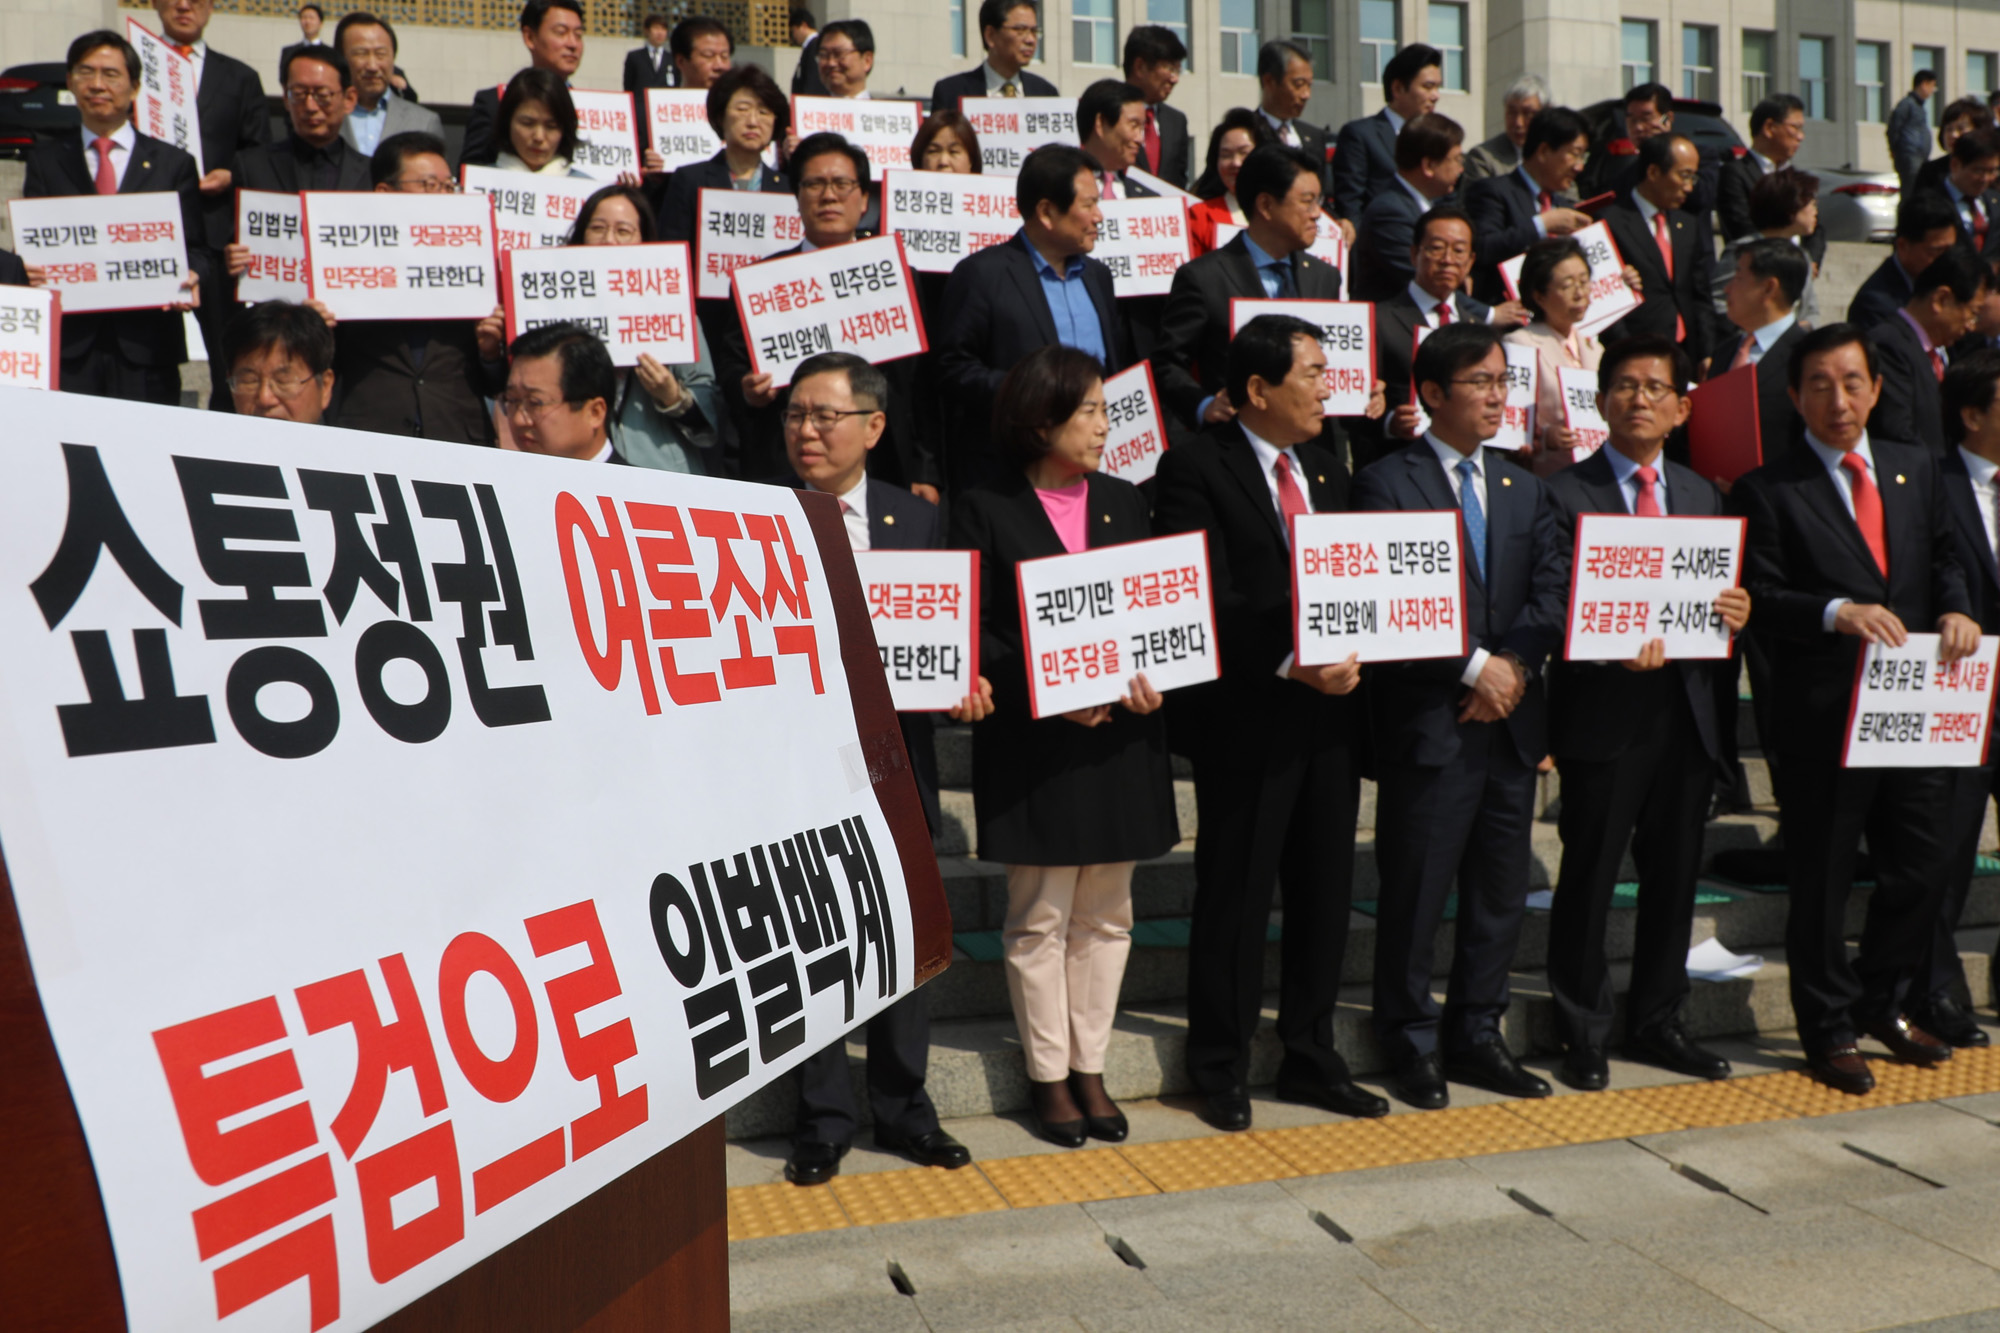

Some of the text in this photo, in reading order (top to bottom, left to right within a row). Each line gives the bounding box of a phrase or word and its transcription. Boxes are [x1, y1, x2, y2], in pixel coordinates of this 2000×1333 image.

[803, 111, 911, 134] 선관위에 압박공작
[970, 113, 1075, 134] 선관위에 압박공작
[659, 135, 712, 155] 청와대는
[546, 194, 587, 220] 전원
[893, 189, 953, 215] 헌정유린
[22, 222, 175, 248] 국민기만 댓글공작
[247, 210, 304, 240] 입법부
[318, 224, 482, 247] 국민기만 댓글공작
[496, 229, 531, 249] 정치
[708, 211, 806, 240] 국회의원 전원
[1127, 215, 1180, 239] 국회사찰
[44, 257, 179, 285] 주당을 규탄한다
[323, 265, 485, 289] 민주당을 규탄한다
[520, 267, 682, 300] 헌정유린 국회사찰
[748, 259, 897, 316] BH출장소 민주당은
[618, 313, 685, 344] 규탄한다
[760, 304, 909, 364] 국민앞에 사죄하라
[1319, 324, 1363, 351] 주당은
[1106, 389, 1148, 432] 주당은
[1103, 429, 1156, 475] 사죄하라
[1304, 540, 1451, 577] BH출장소 민주당은
[1586, 545, 1731, 580] 국정원댓글 수사하듯
[29, 441, 826, 759] 쇼통정권 여론조작
[868, 583, 961, 621] 댓글공작
[1035, 565, 1200, 627] 국민기만 댓글공작
[1307, 596, 1454, 638] 국민앞에 사죄하라
[1581, 600, 1650, 635] 댓글공작
[1040, 622, 1206, 688] 민주당을 규탄한다
[1868, 659, 1990, 692] 헌정유린 국회사찰
[1858, 712, 1981, 743] 문재인정권 규탄한다
[151, 813, 898, 1333] 특검으로 일벌백계
